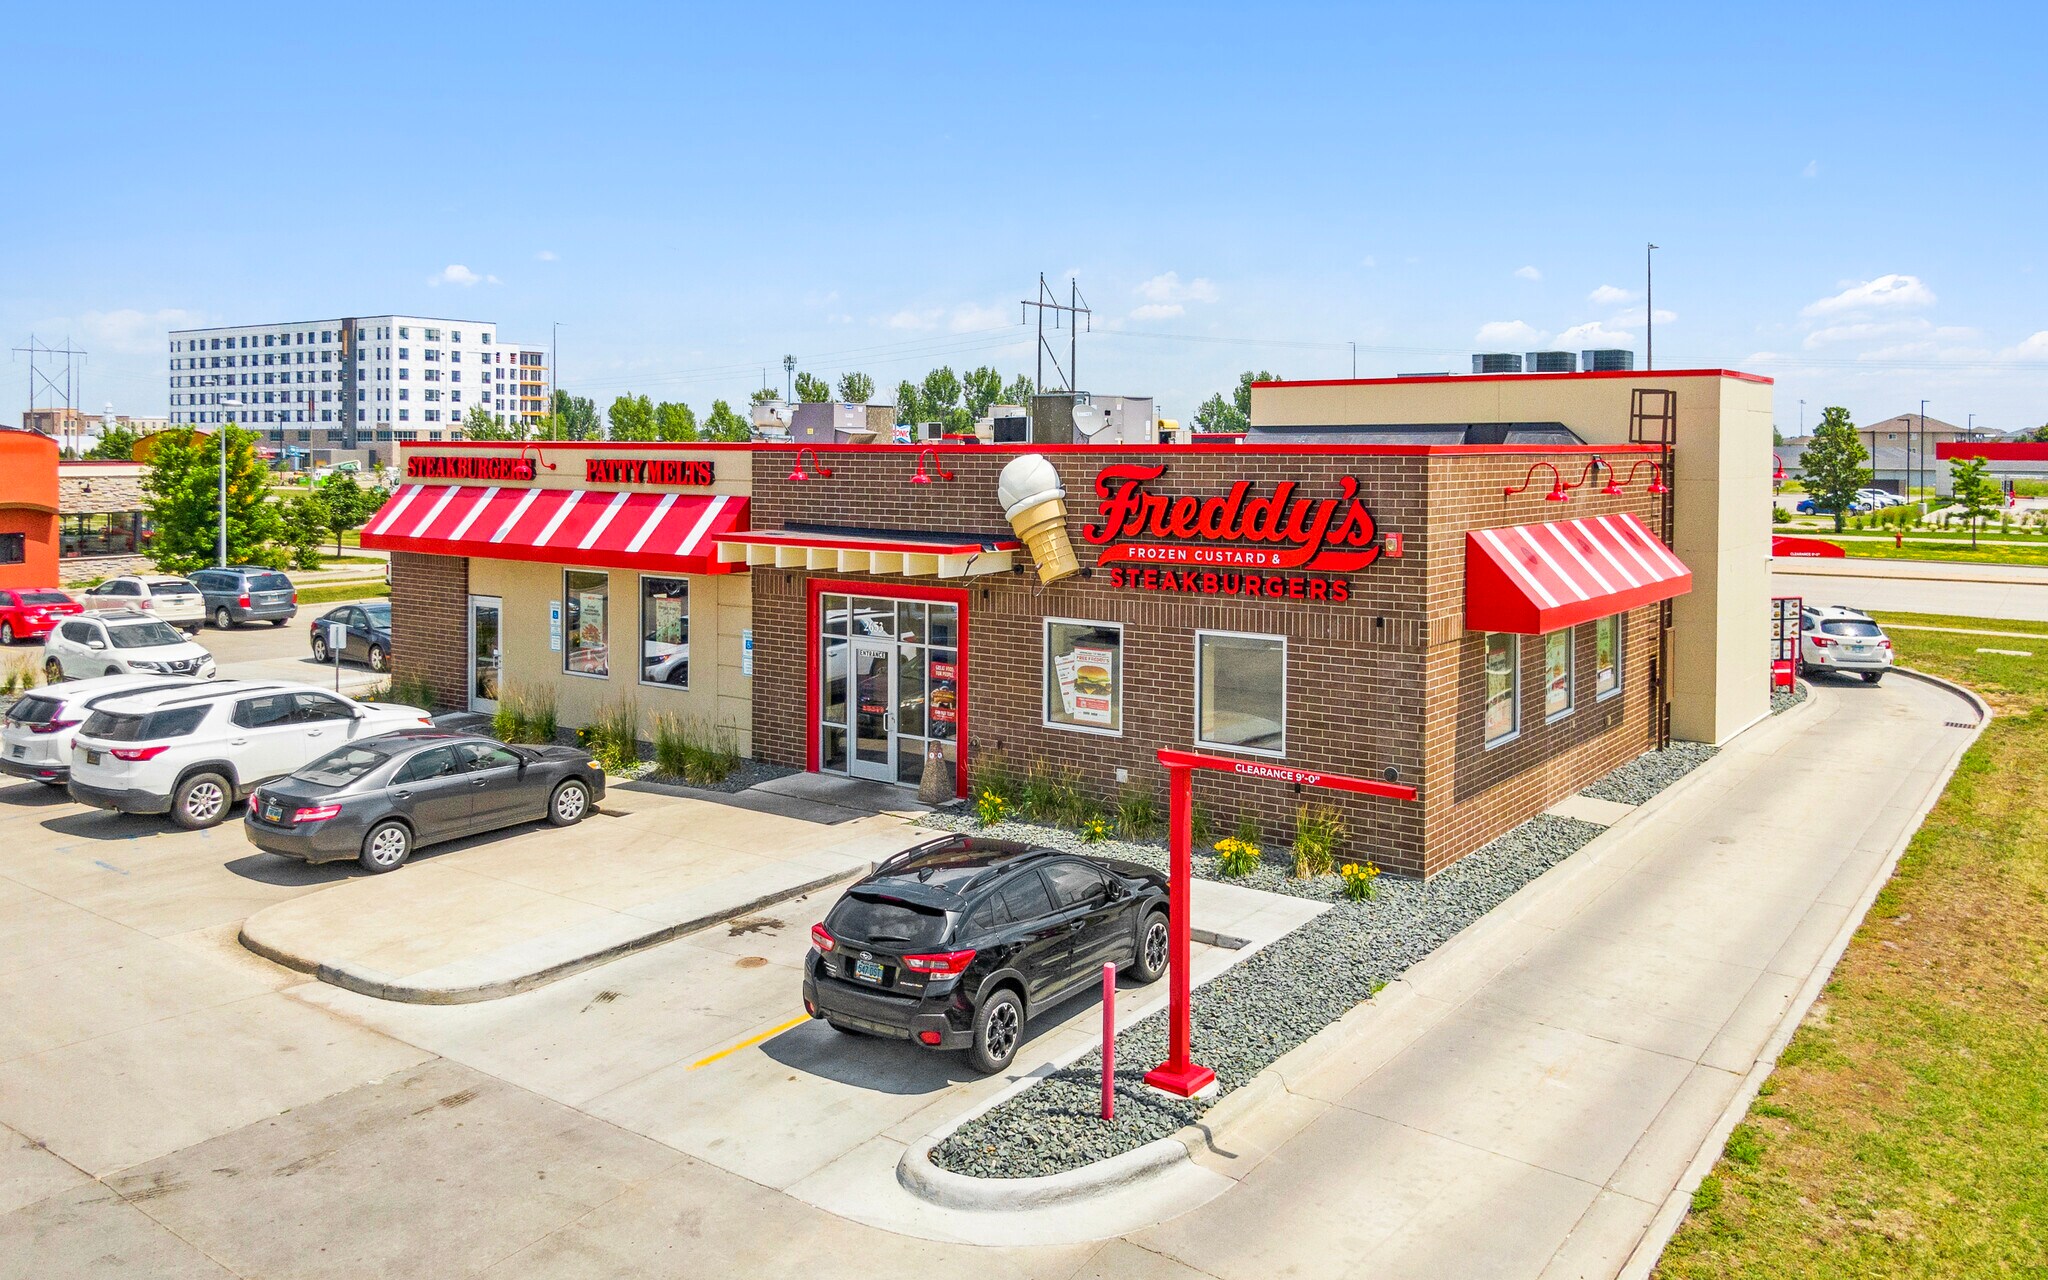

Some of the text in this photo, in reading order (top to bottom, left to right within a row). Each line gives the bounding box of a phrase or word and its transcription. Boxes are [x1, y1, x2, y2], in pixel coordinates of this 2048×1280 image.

[407, 456, 534, 481] STEAKBURGERS
[585, 458, 713, 486] PATTY MELTS
[1082, 464, 1377, 558] Freddy's
[1128, 547, 1281, 565] FROZEN CUSTARD &
[1110, 567, 1349, 602] STEAKBURGERS
[860, 649, 886, 659] ENTRANCE
[1235, 763, 1320, 784] CLEARANCE 9'-0"
